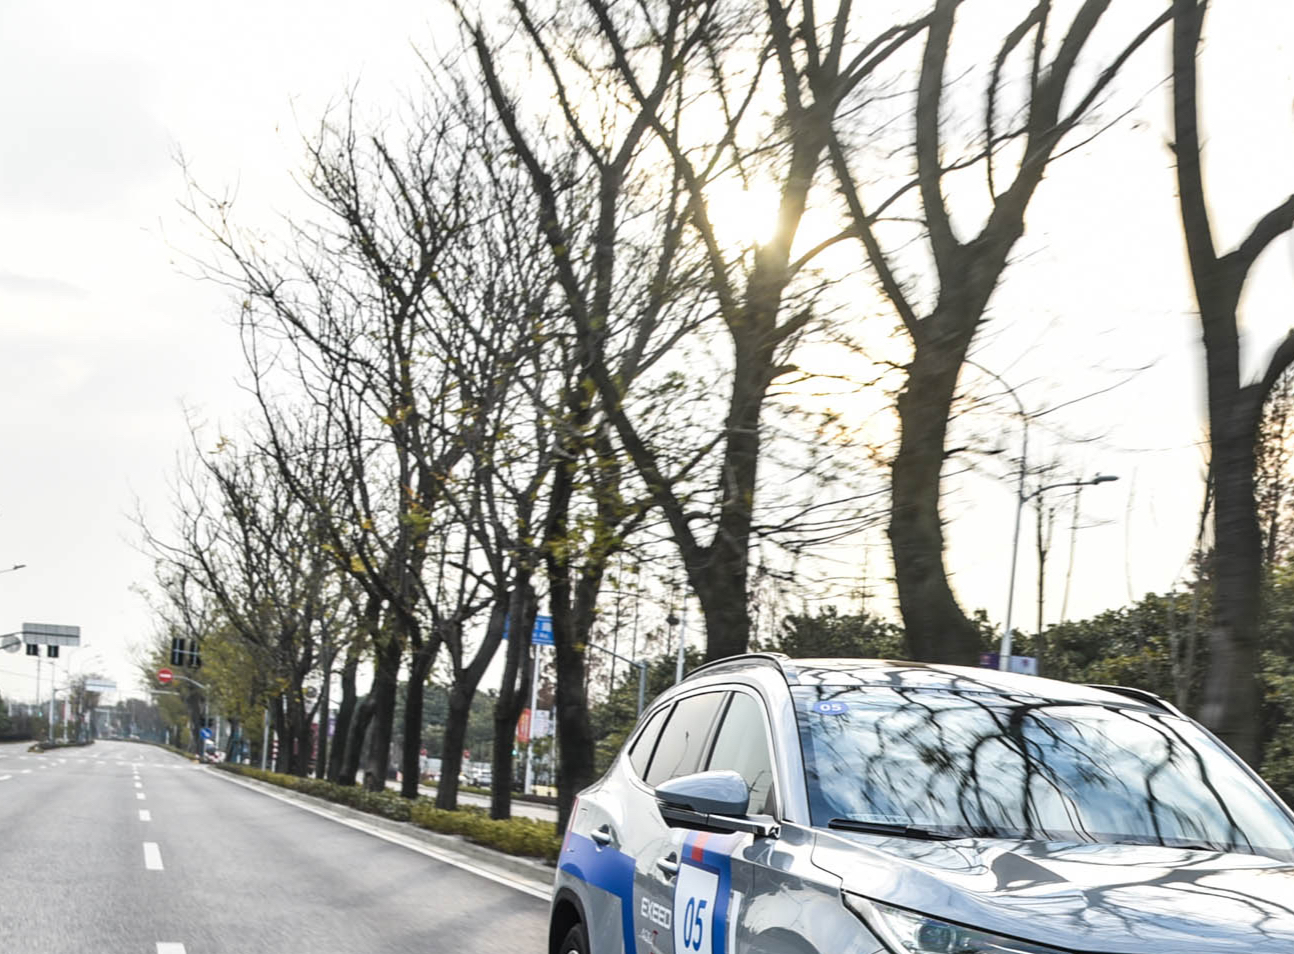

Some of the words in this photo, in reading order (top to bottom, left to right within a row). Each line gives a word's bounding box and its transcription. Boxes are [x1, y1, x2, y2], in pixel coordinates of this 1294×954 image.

[820, 703, 843, 712] 05
[640, 896, 672, 929] EXEED
[683, 897, 708, 951] 05
